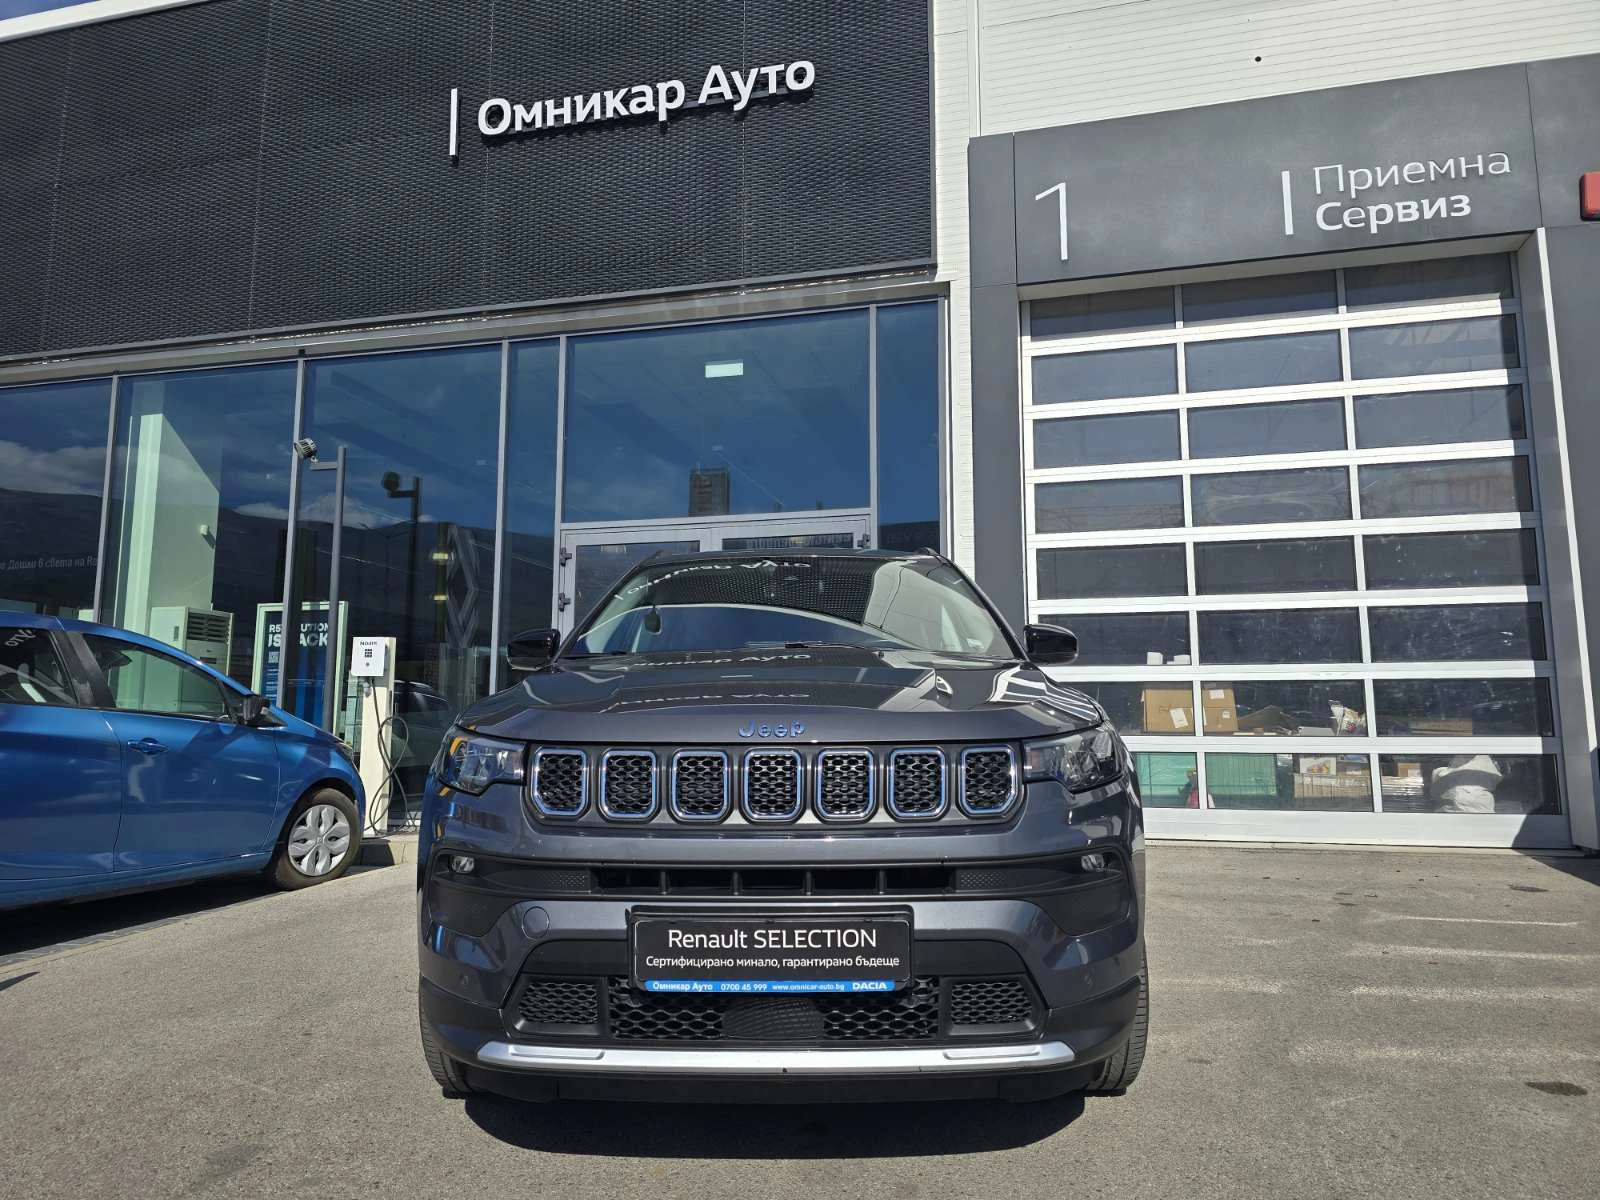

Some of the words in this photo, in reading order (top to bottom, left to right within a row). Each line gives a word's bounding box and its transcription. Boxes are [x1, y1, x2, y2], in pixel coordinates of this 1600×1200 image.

[477, 78, 686, 136] Омникар
[698, 60, 816, 112] Ауто
[1313, 152, 1512, 199] Приемна
[1035, 181, 1068, 262] 1
[1315, 193, 1472, 234] Сервиз
[299, 632, 328, 647] ACK
[738, 720, 806, 738] Jeep
[668, 929, 748, 949] Renault
[753, 928, 877, 949] SELECTION
[646, 955, 734, 969] Сертифицирано
[736, 957, 780, 969] минало,
[782, 957, 853, 969] гарантирано
[855, 955, 900, 967] бъдеще
[652, 982, 690, 991] Омникар
[692, 982, 713, 992] Ауто
[720, 983, 740, 991] 0700
[741, 983, 752, 991] 45
[753, 983, 768, 991] 999
[852, 981, 888, 991] DACIA
